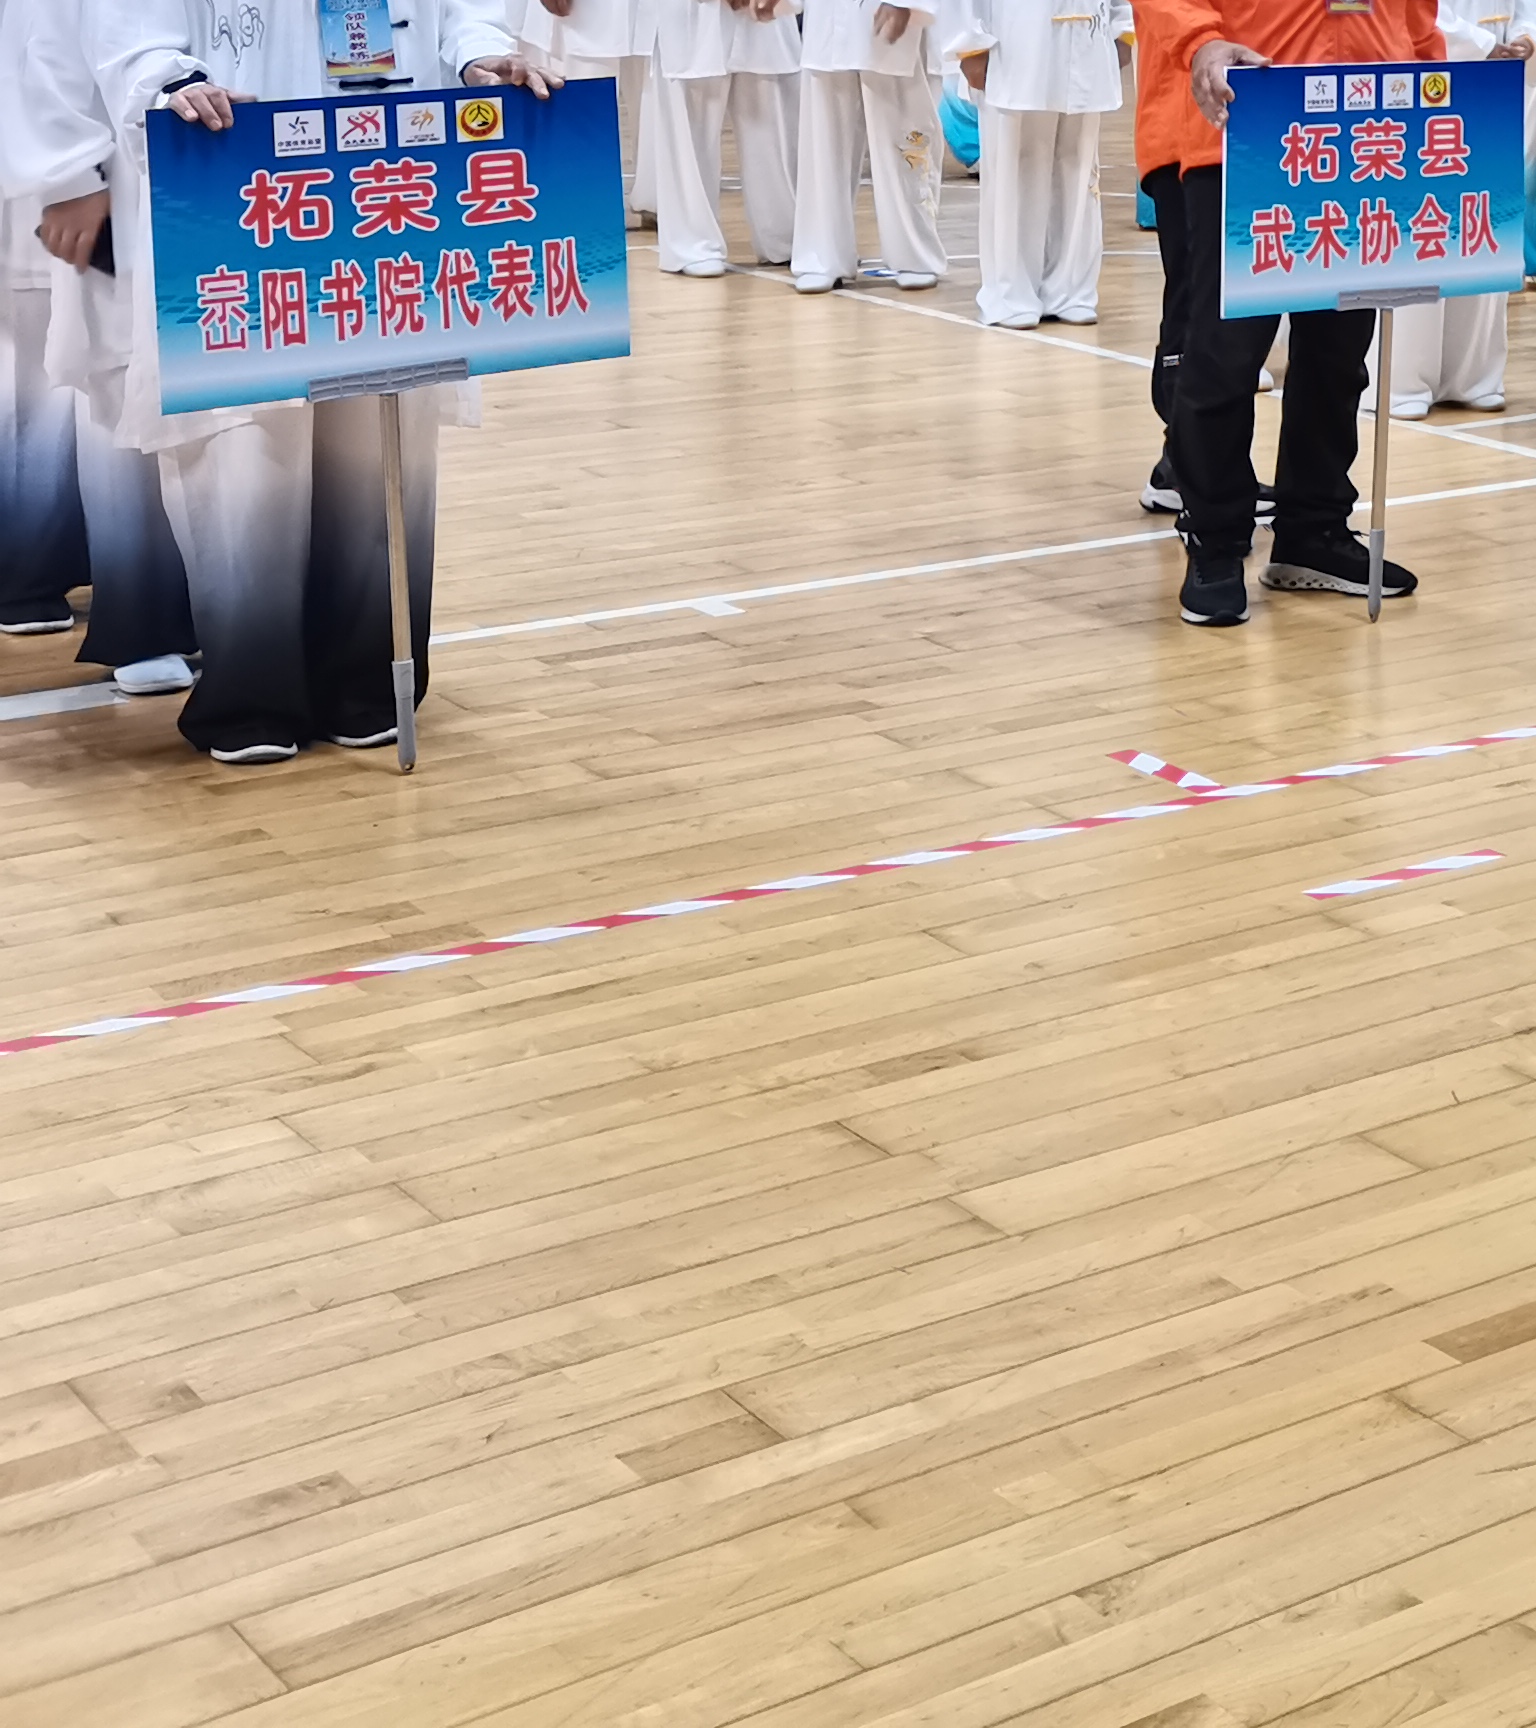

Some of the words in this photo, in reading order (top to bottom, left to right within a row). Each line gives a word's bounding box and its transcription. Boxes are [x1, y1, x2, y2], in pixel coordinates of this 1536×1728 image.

[1281, 114, 1470, 186] 柘荣县
[239, 148, 539, 248] 柘荣县
[1250, 190, 1500, 276] 武术协会队
